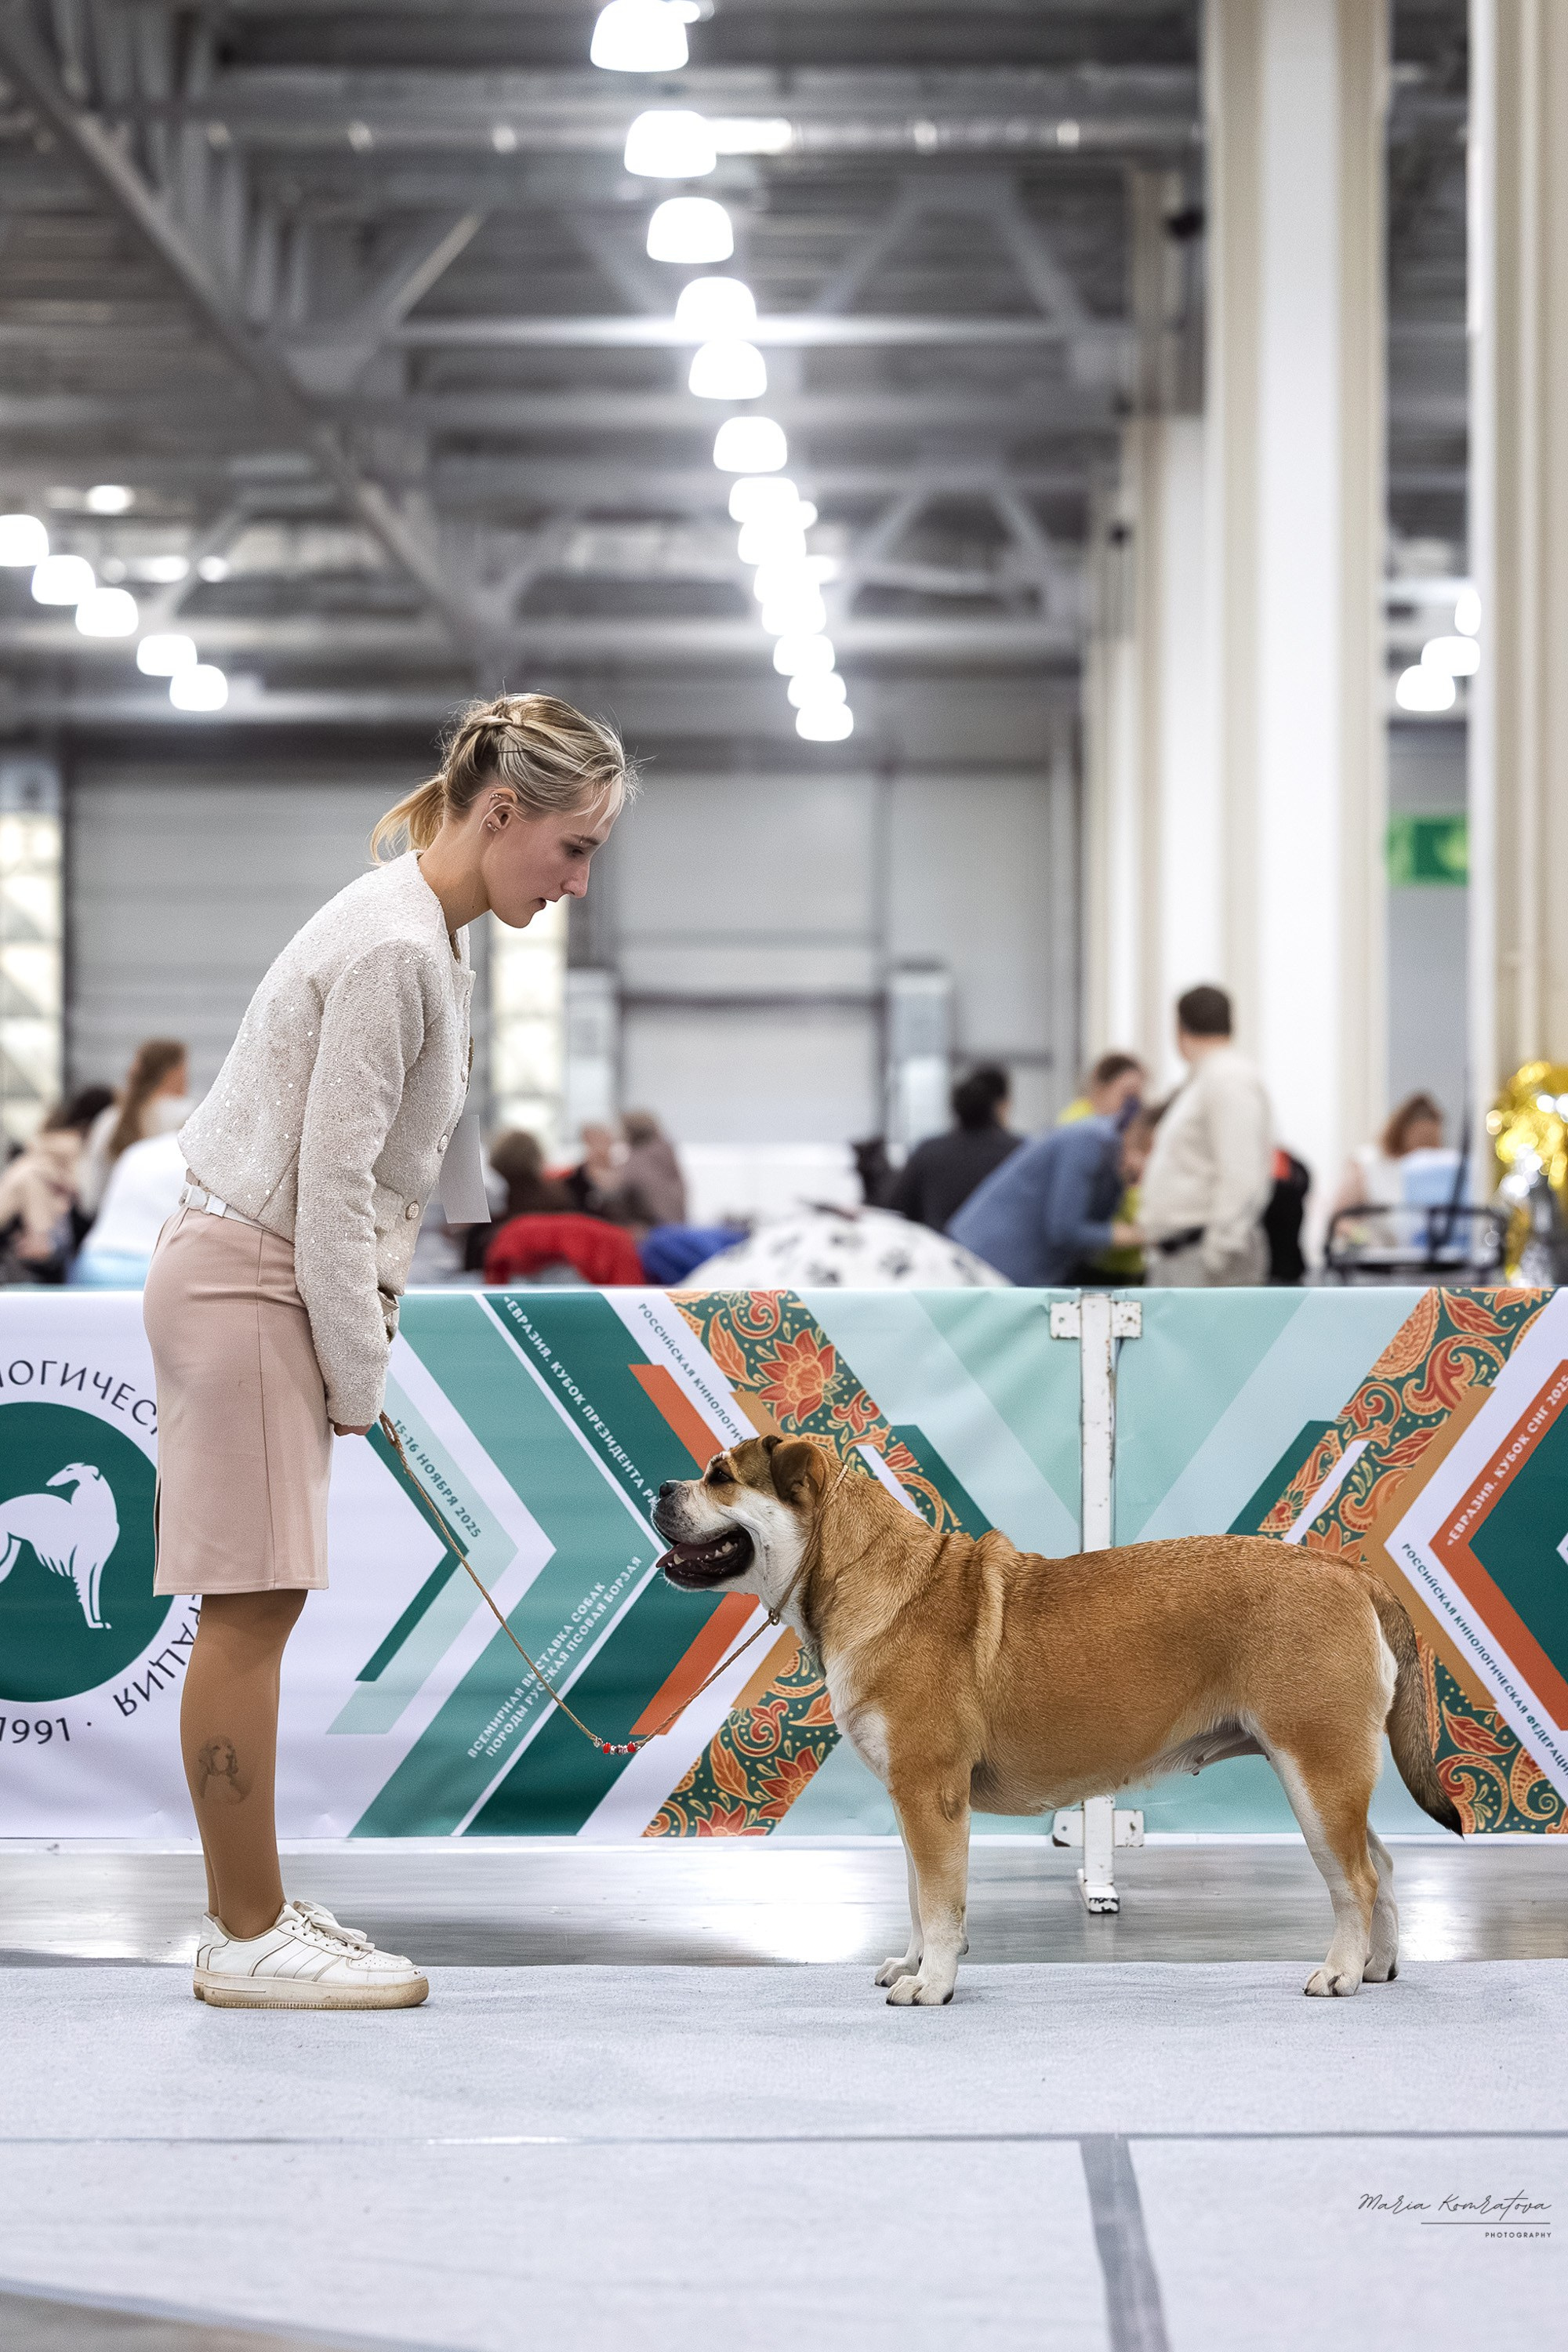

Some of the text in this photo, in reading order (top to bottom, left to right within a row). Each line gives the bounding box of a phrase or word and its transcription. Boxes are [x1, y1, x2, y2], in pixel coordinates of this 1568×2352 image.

[0, 1359, 157, 1436] ОГИЧЕС
[638, 1303, 695, 1377] РОССИЙСКАЯ
[394, 1420, 481, 1537] 15-16 НОЯБРЯ 2025
[550, 1361, 586, 1405] КУБОК
[582, 1405, 644, 1489] ПРЕЗИДЕНТА
[1494, 1434, 1530, 1479] КУБОК
[1526, 1405, 1549, 1433] СНГ
[467, 1582, 606, 1758] ВСЕМИРНАЯ ВЫСТАВКА СОБАК
[485, 1555, 642, 1758] ПОРОДЫ РУССКАЯ ПСОВАЯ БОРЗАЯ
[1401, 1543, 1456, 1617] РОССИЙСКАЯ
[1454, 1615, 1528, 1714] КИНОЛОГИЧЕСКАЯ
[0, 1716, 70, 1744] 1991
